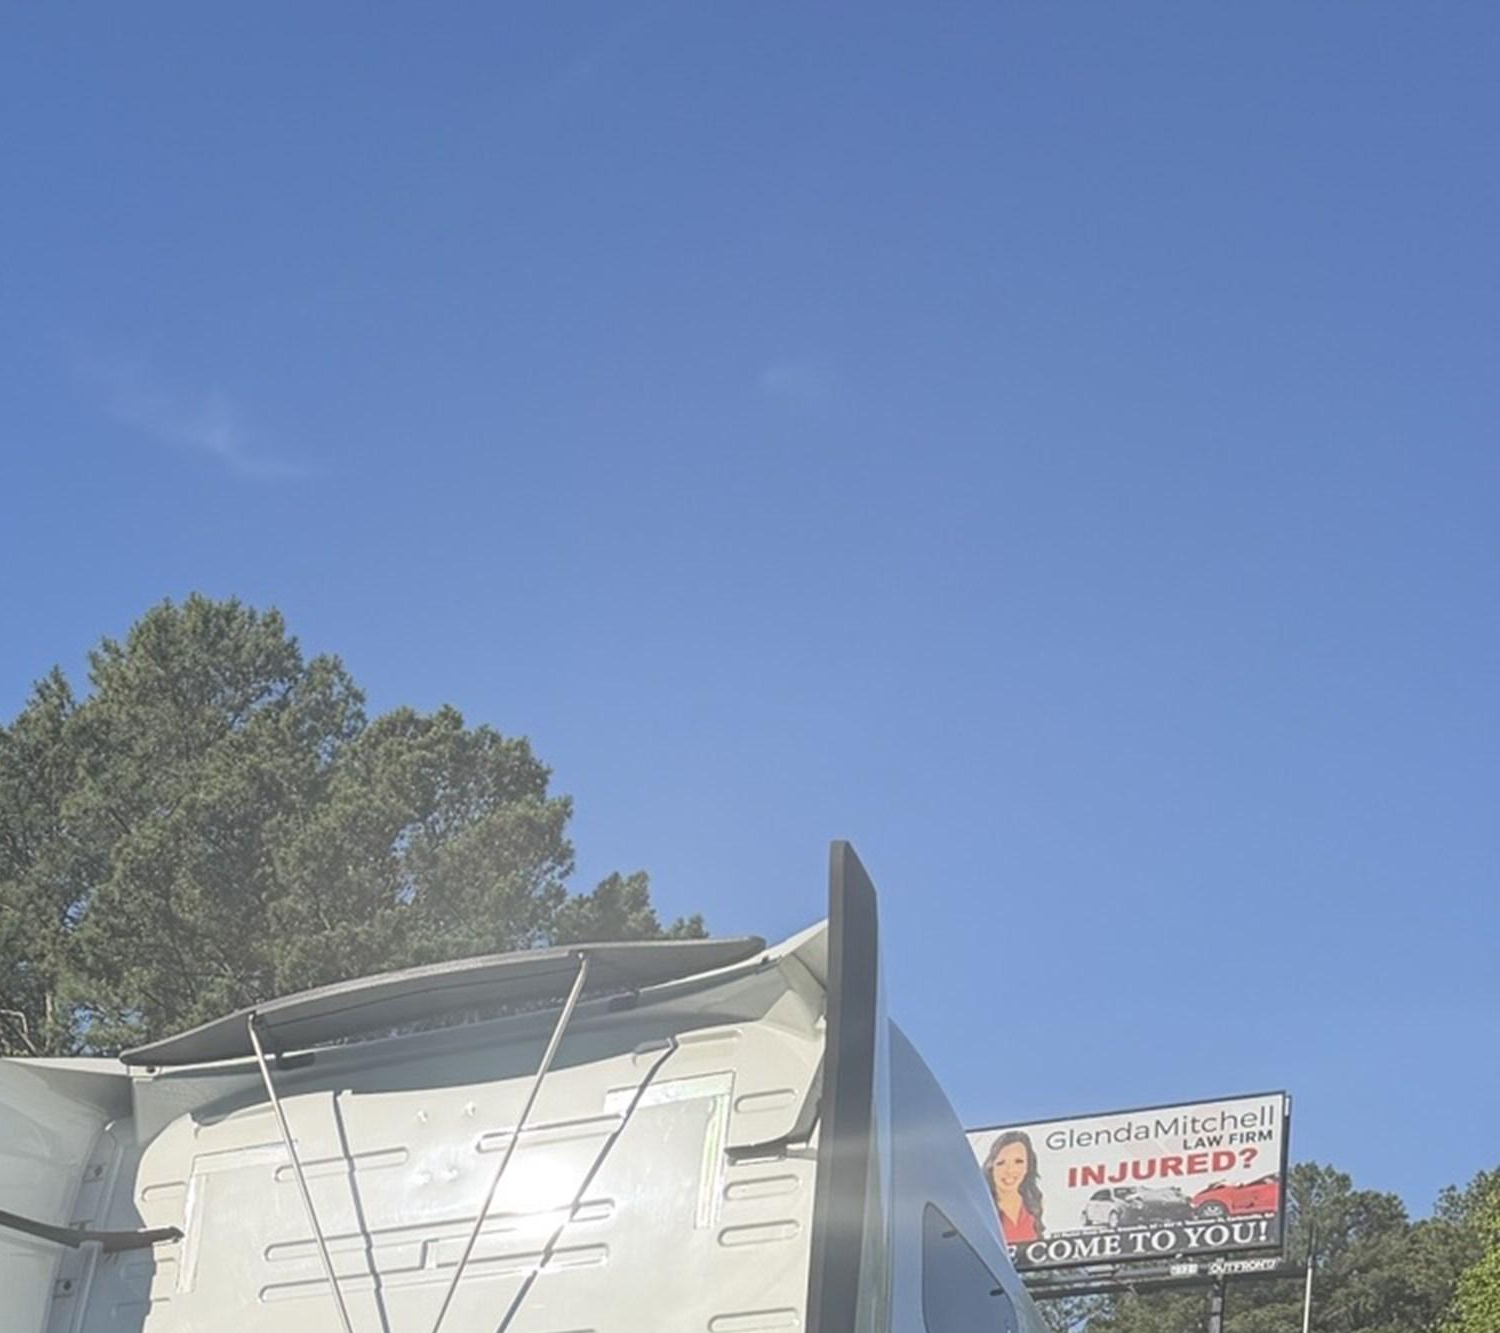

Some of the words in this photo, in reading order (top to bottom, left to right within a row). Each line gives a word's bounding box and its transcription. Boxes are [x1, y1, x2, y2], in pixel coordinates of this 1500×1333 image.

[1183, 1135, 1223, 1151] LAW
[1229, 1129, 1273, 1146] FIRM
[1068, 1147, 1259, 1188] INJURED?
[1026, 1234, 1122, 1263] COME
[1129, 1229, 1176, 1253] TO
[1184, 1220, 1268, 1248] YOU!
